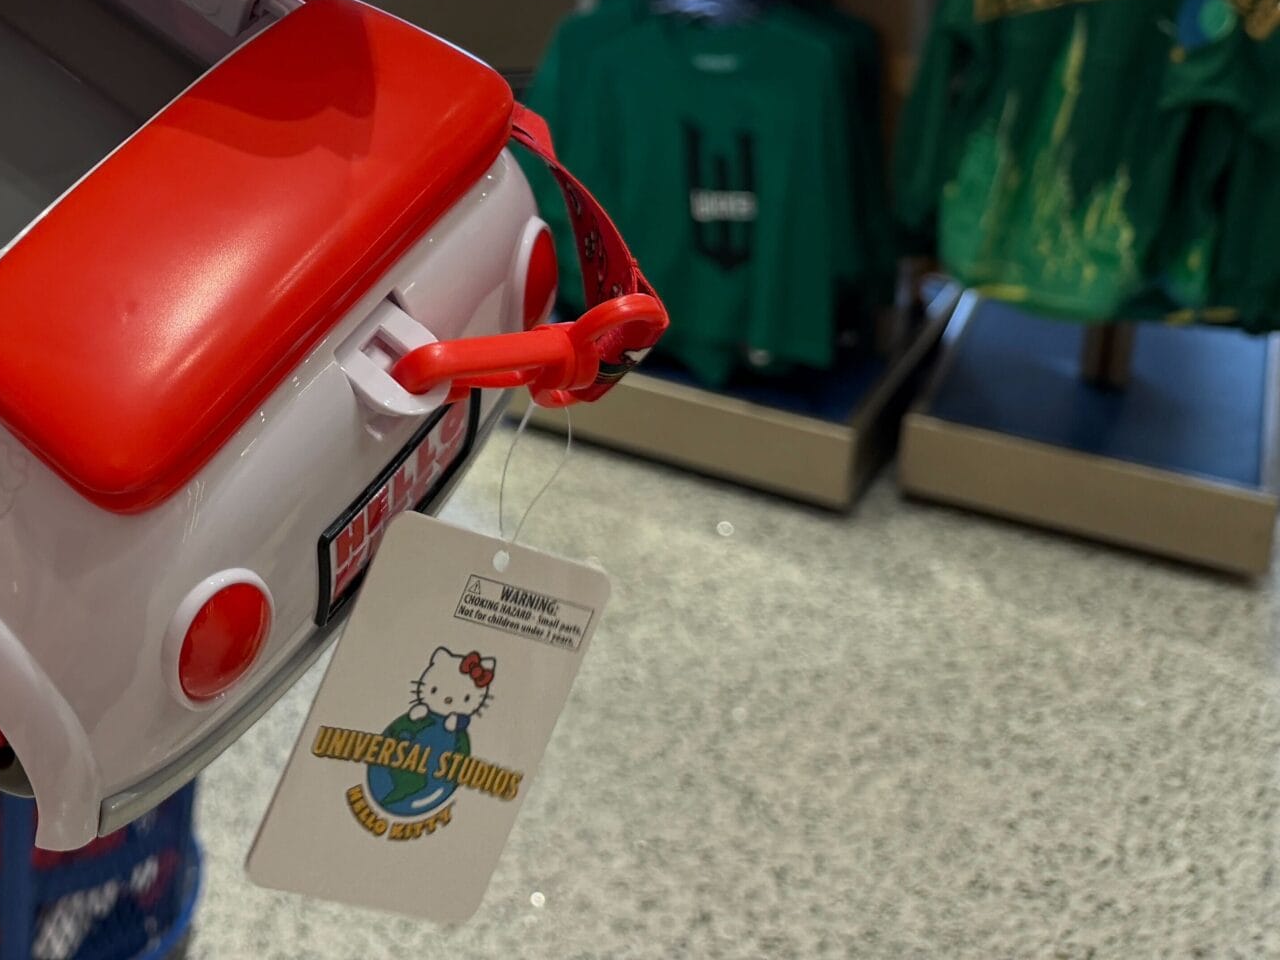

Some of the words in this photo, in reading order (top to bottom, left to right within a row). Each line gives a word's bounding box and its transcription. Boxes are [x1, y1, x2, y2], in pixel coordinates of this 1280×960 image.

[463, 593, 499, 613] CHOKING
[499, 604, 532, 620] HAZARD
[500, 585, 558, 616] WARNING:
[457, 605, 473, 617] Not
[474, 611, 487, 620] for
[487, 613, 520, 630] children
[312, 725, 431, 774] UNIVERSAL
[433, 750, 524, 801] STUDIOS
[345, 784, 389, 836] HELLO
[388, 804, 453, 840] KITTY
